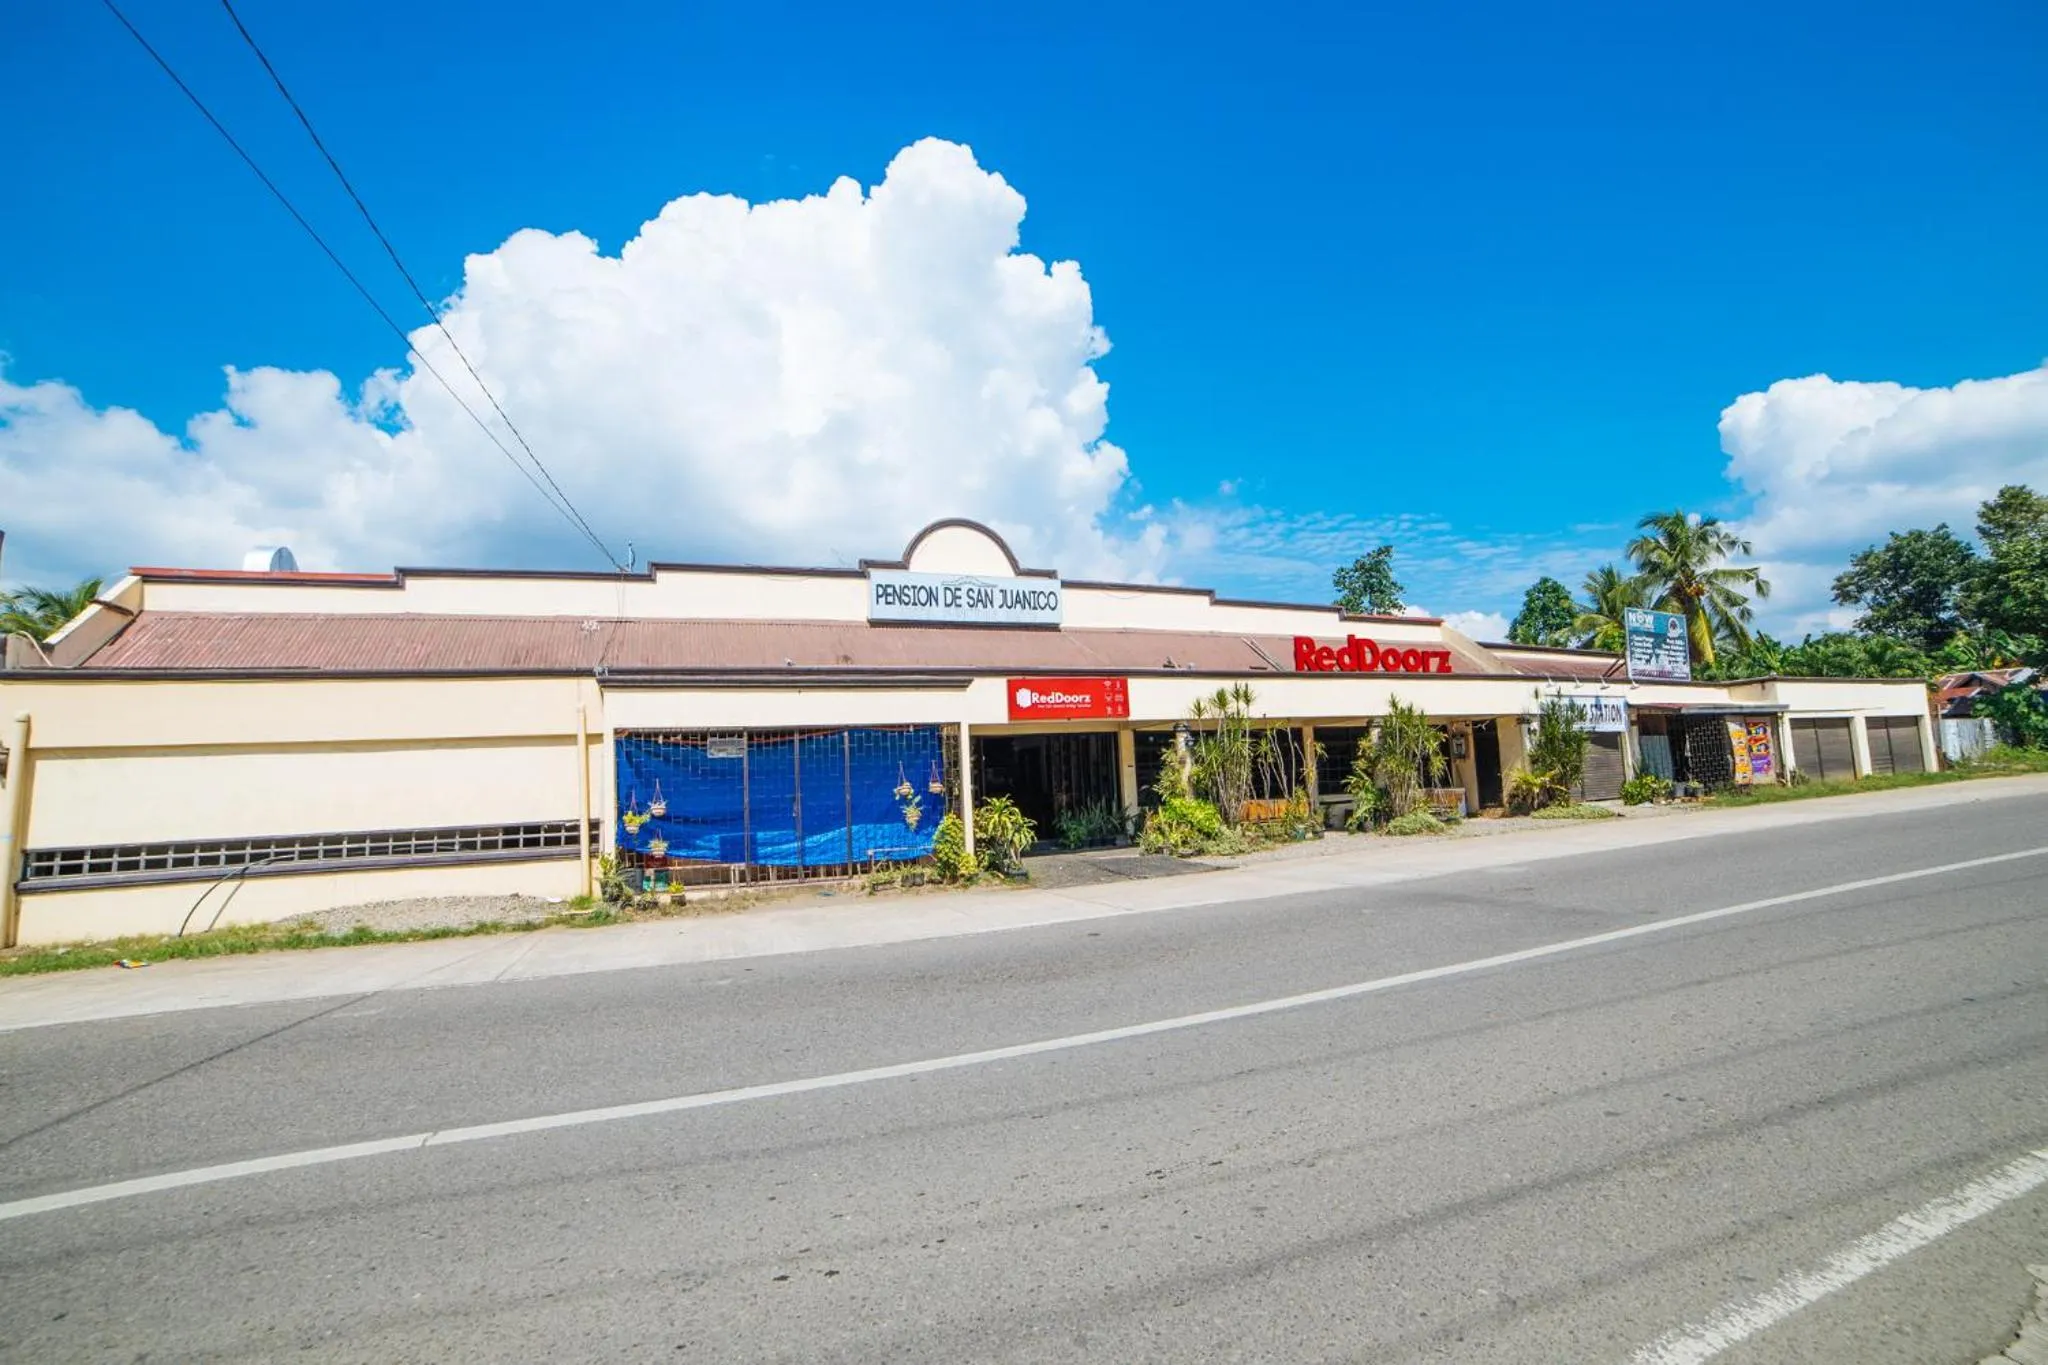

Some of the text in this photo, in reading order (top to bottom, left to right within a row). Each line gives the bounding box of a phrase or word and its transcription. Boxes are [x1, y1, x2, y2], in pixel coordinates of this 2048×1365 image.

[876, 584, 1058, 611] PENSION DE SAN JUANICO
[1293, 634, 1452, 673] RedDoorz
[1031, 691, 1092, 704] RedDoorz
[1590, 703, 1623, 723] STATION
